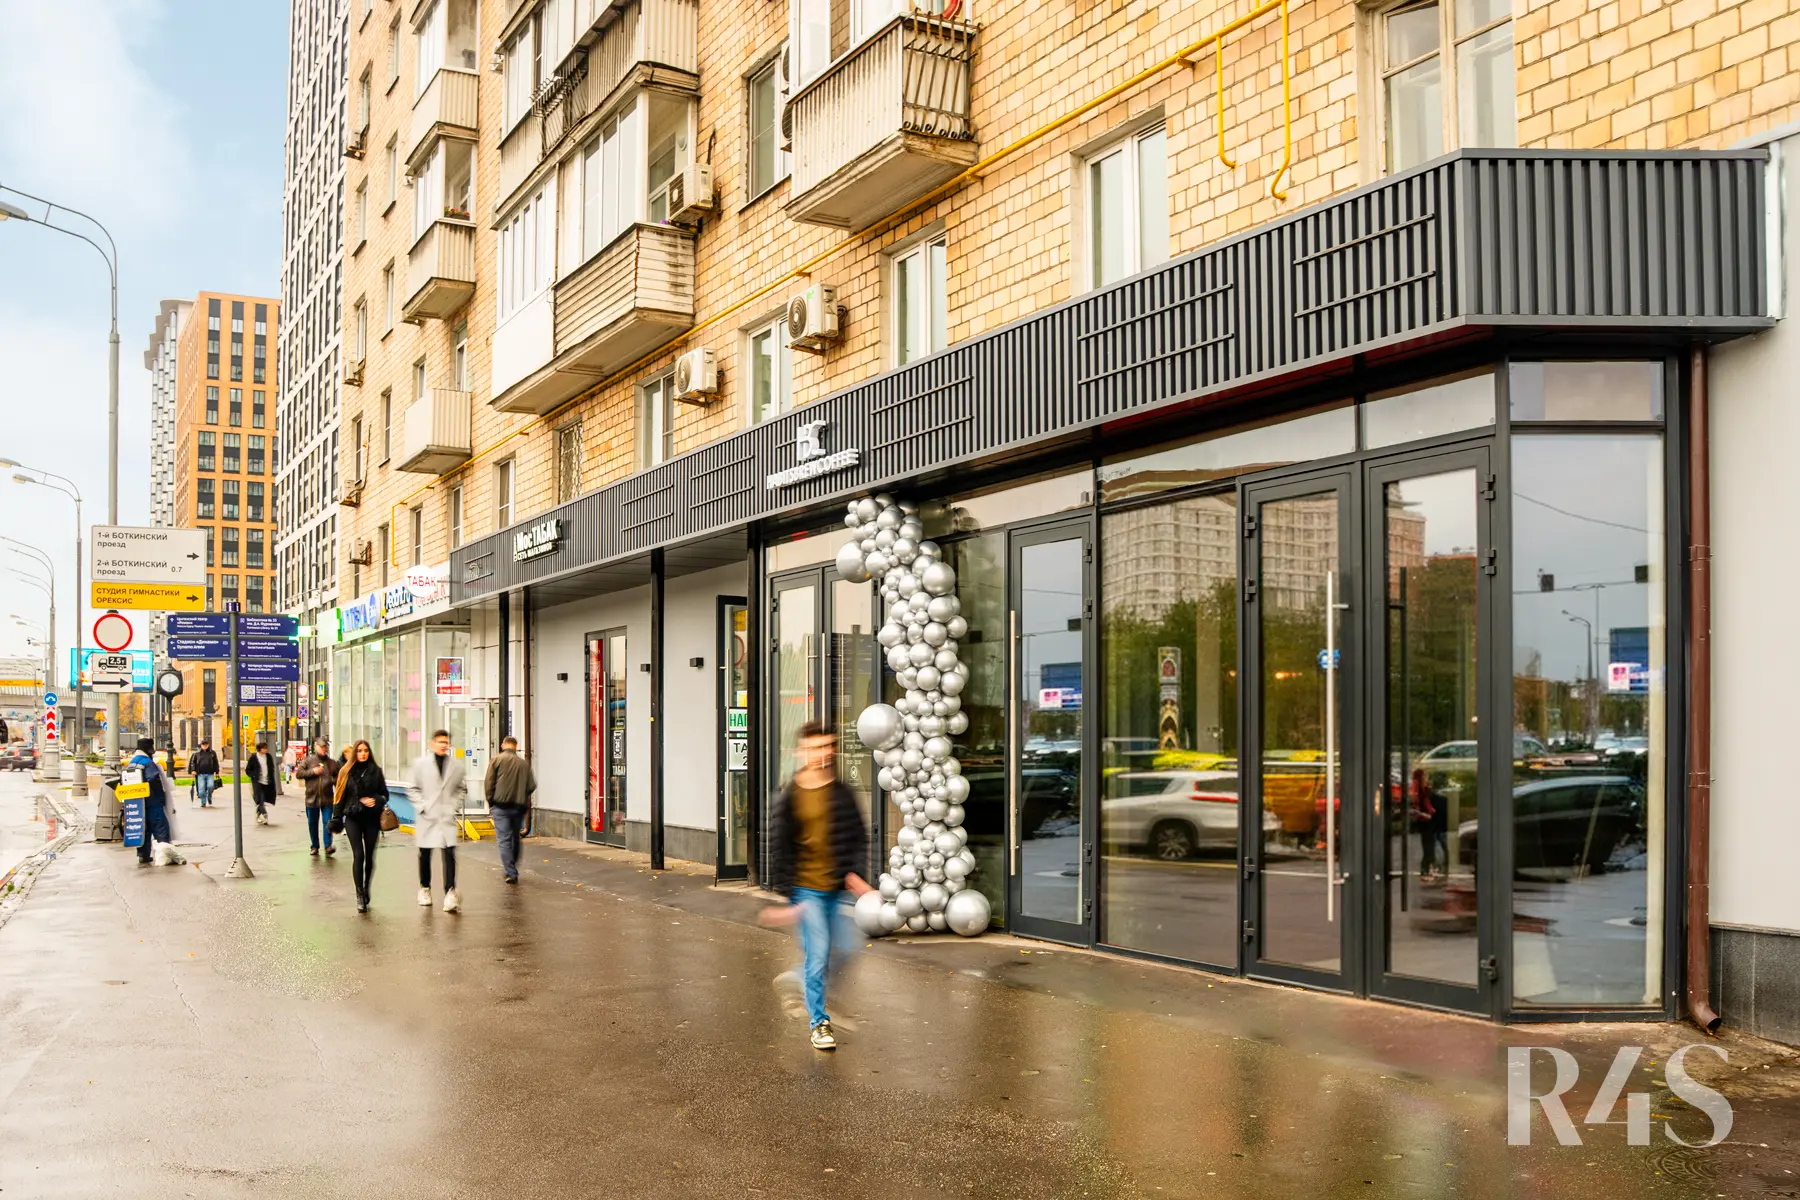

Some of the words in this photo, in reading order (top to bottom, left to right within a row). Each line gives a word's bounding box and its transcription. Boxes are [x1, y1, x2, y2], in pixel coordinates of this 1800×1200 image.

[817, 448, 859, 473] COFFEE
[112, 532, 168, 541] БОТКИНСКИЙ
[111, 560, 168, 568] БОТКИНСКИЙ
[97, 568, 126, 576] проезд
[407, 575, 437, 587] ТАБАК
[96, 587, 127, 595] СТУДИЯ
[128, 588, 181, 597] ГИМНАСТИКИ
